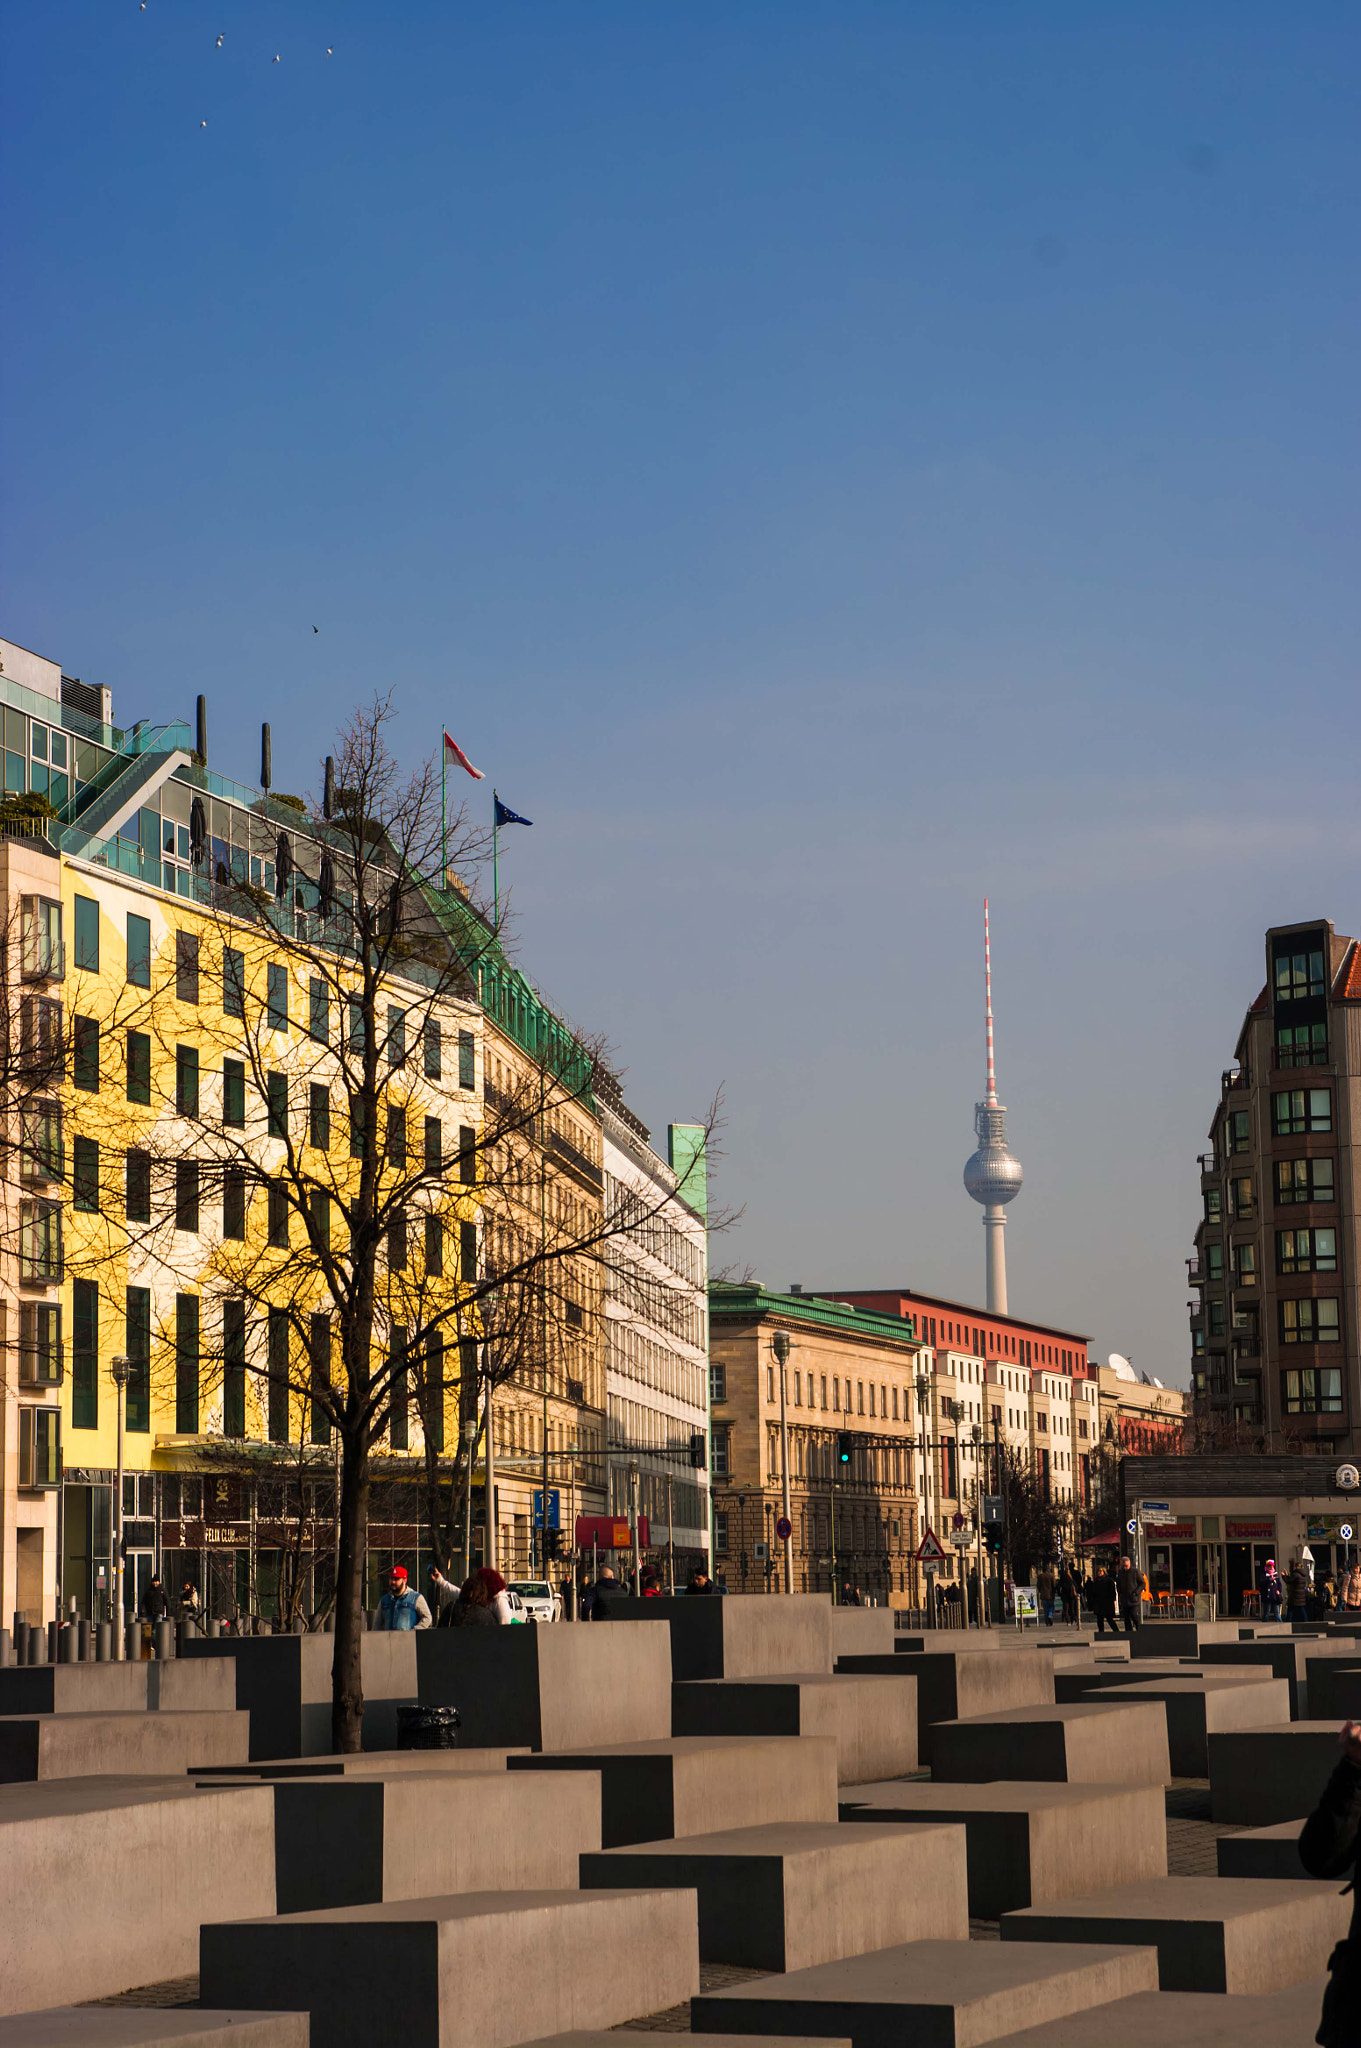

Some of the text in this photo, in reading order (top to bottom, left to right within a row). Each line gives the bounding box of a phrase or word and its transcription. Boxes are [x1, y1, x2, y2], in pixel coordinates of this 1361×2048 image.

[205, 1528, 220, 1542] FELIX
[221, 1528, 235, 1542] CLUB
[1158, 1530, 1193, 1538] DONUTS
